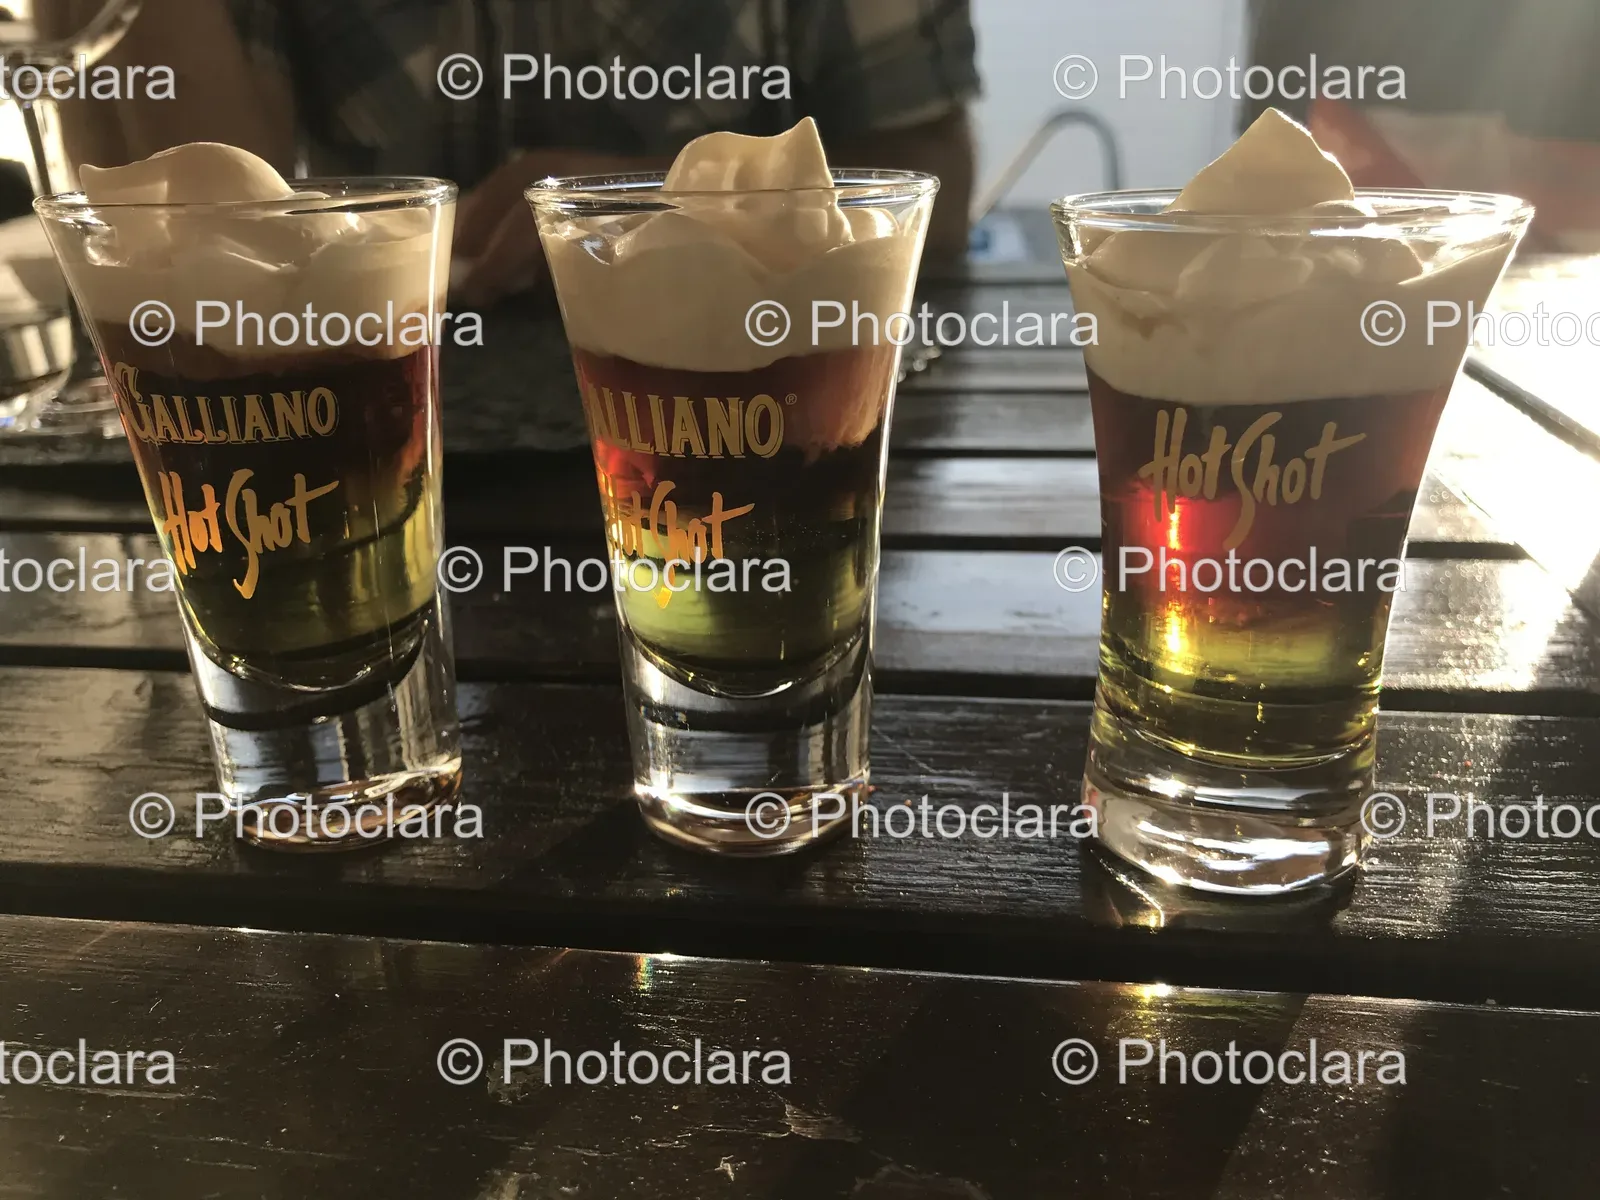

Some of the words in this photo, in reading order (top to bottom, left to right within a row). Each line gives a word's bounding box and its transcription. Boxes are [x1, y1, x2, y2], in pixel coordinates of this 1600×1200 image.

[115, 361, 340, 445] GALLIANO
[158, 471, 223, 576] Hot
[225, 468, 340, 600] Shot
[1138, 407, 1232, 523] Hot
[1223, 411, 1367, 551] Shot
[649, 480, 756, 609] Shot
